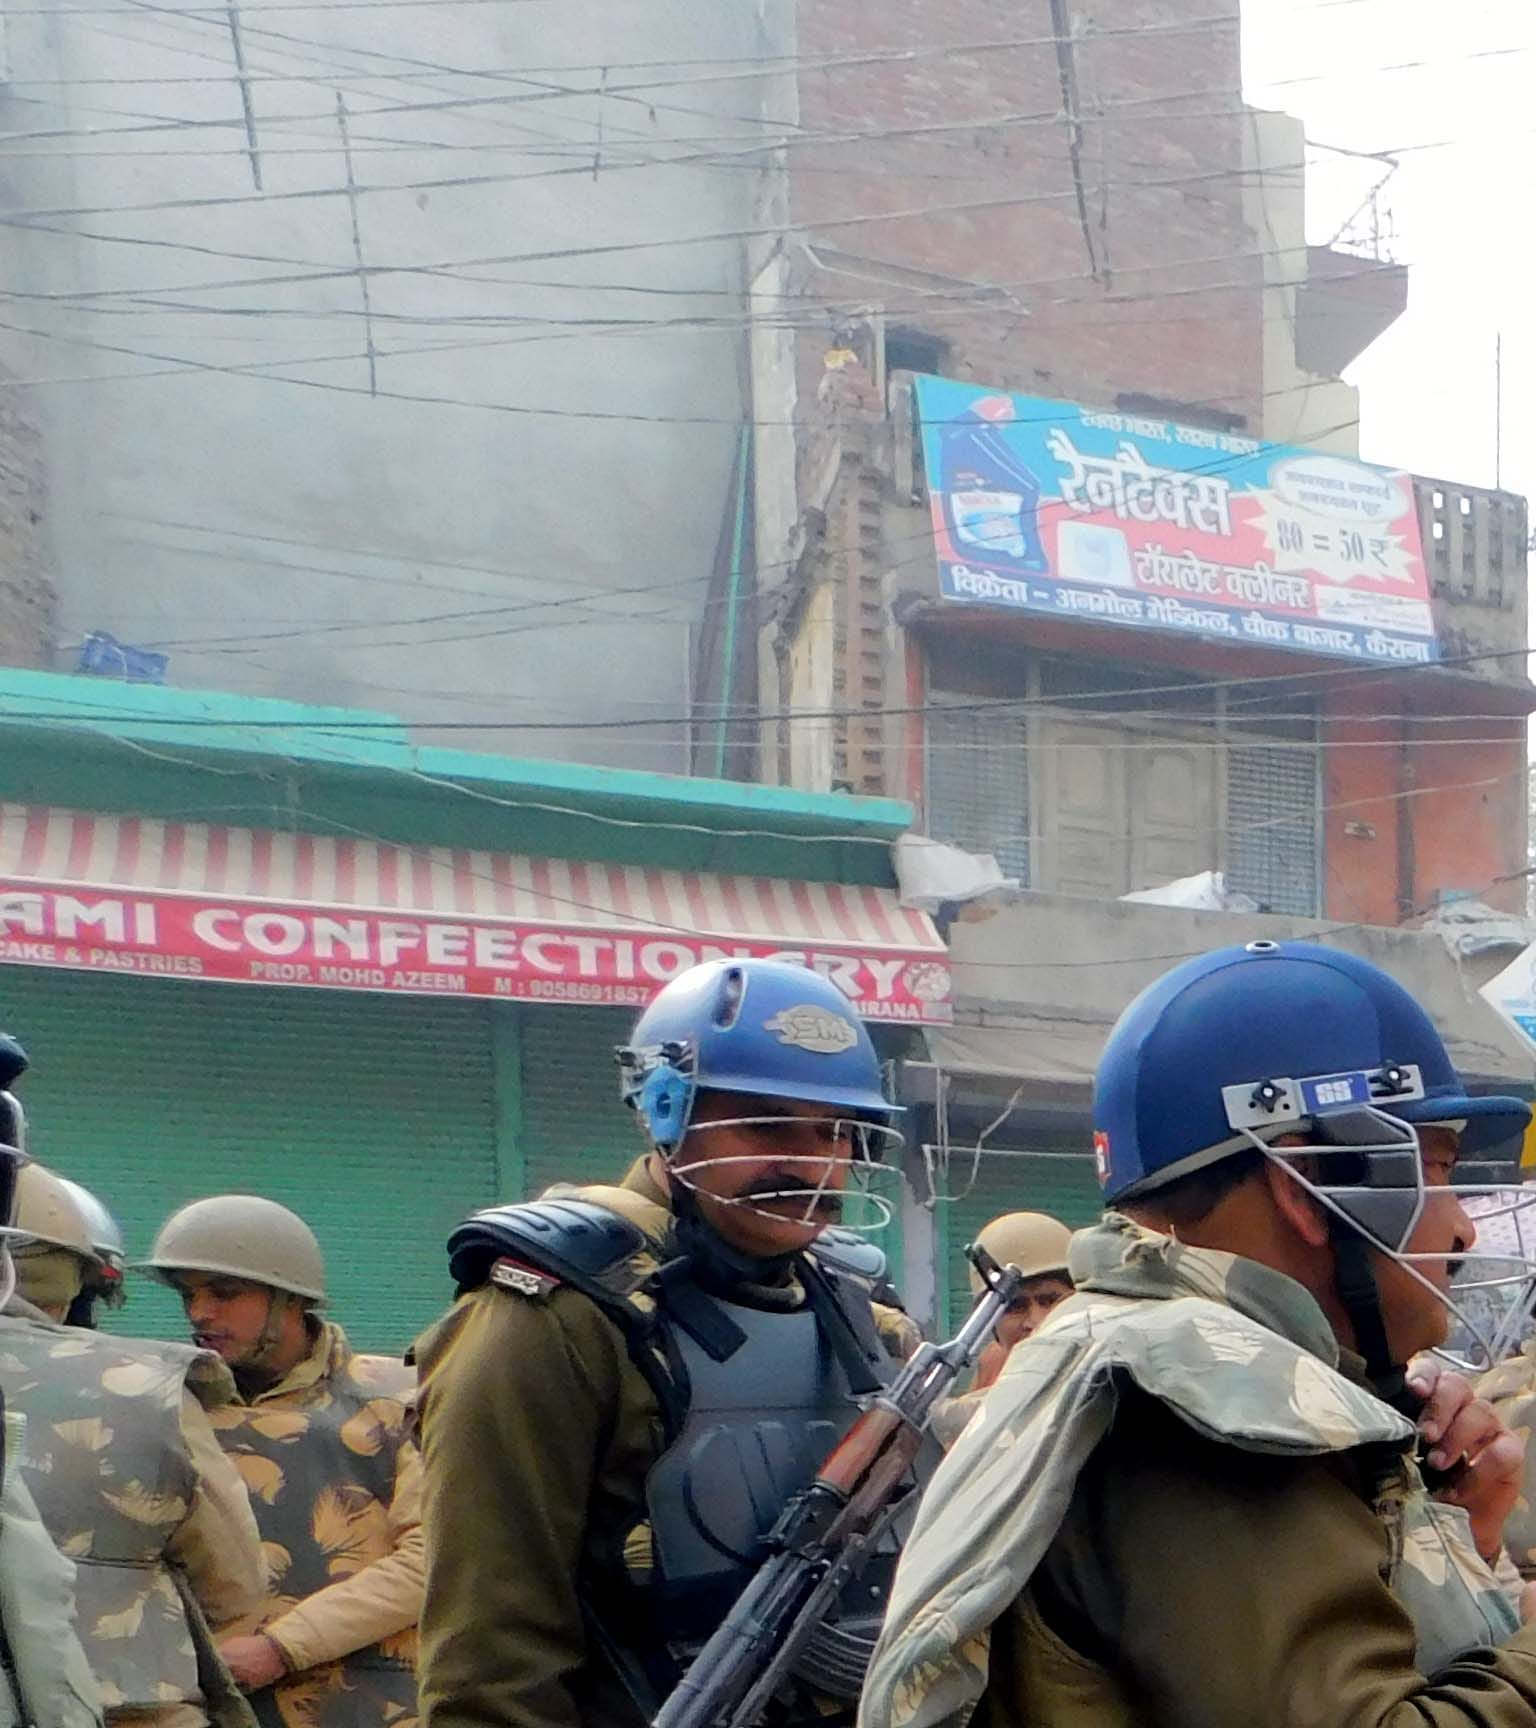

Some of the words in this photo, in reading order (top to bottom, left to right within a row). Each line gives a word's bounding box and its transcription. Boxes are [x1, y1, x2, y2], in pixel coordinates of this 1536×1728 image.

[951, 565, 1027, 603] विक्रेता
[64, 946, 81, 962] &
[90, 948, 203, 973] PASTRIES
[250, 960, 313, 982] PROP.
[319, 966, 386, 987] MOHD
[391, 974, 466, 992] AZEEM
[494, 977, 512, 993] M
[192, 907, 906, 999] CONFEECTIORY
